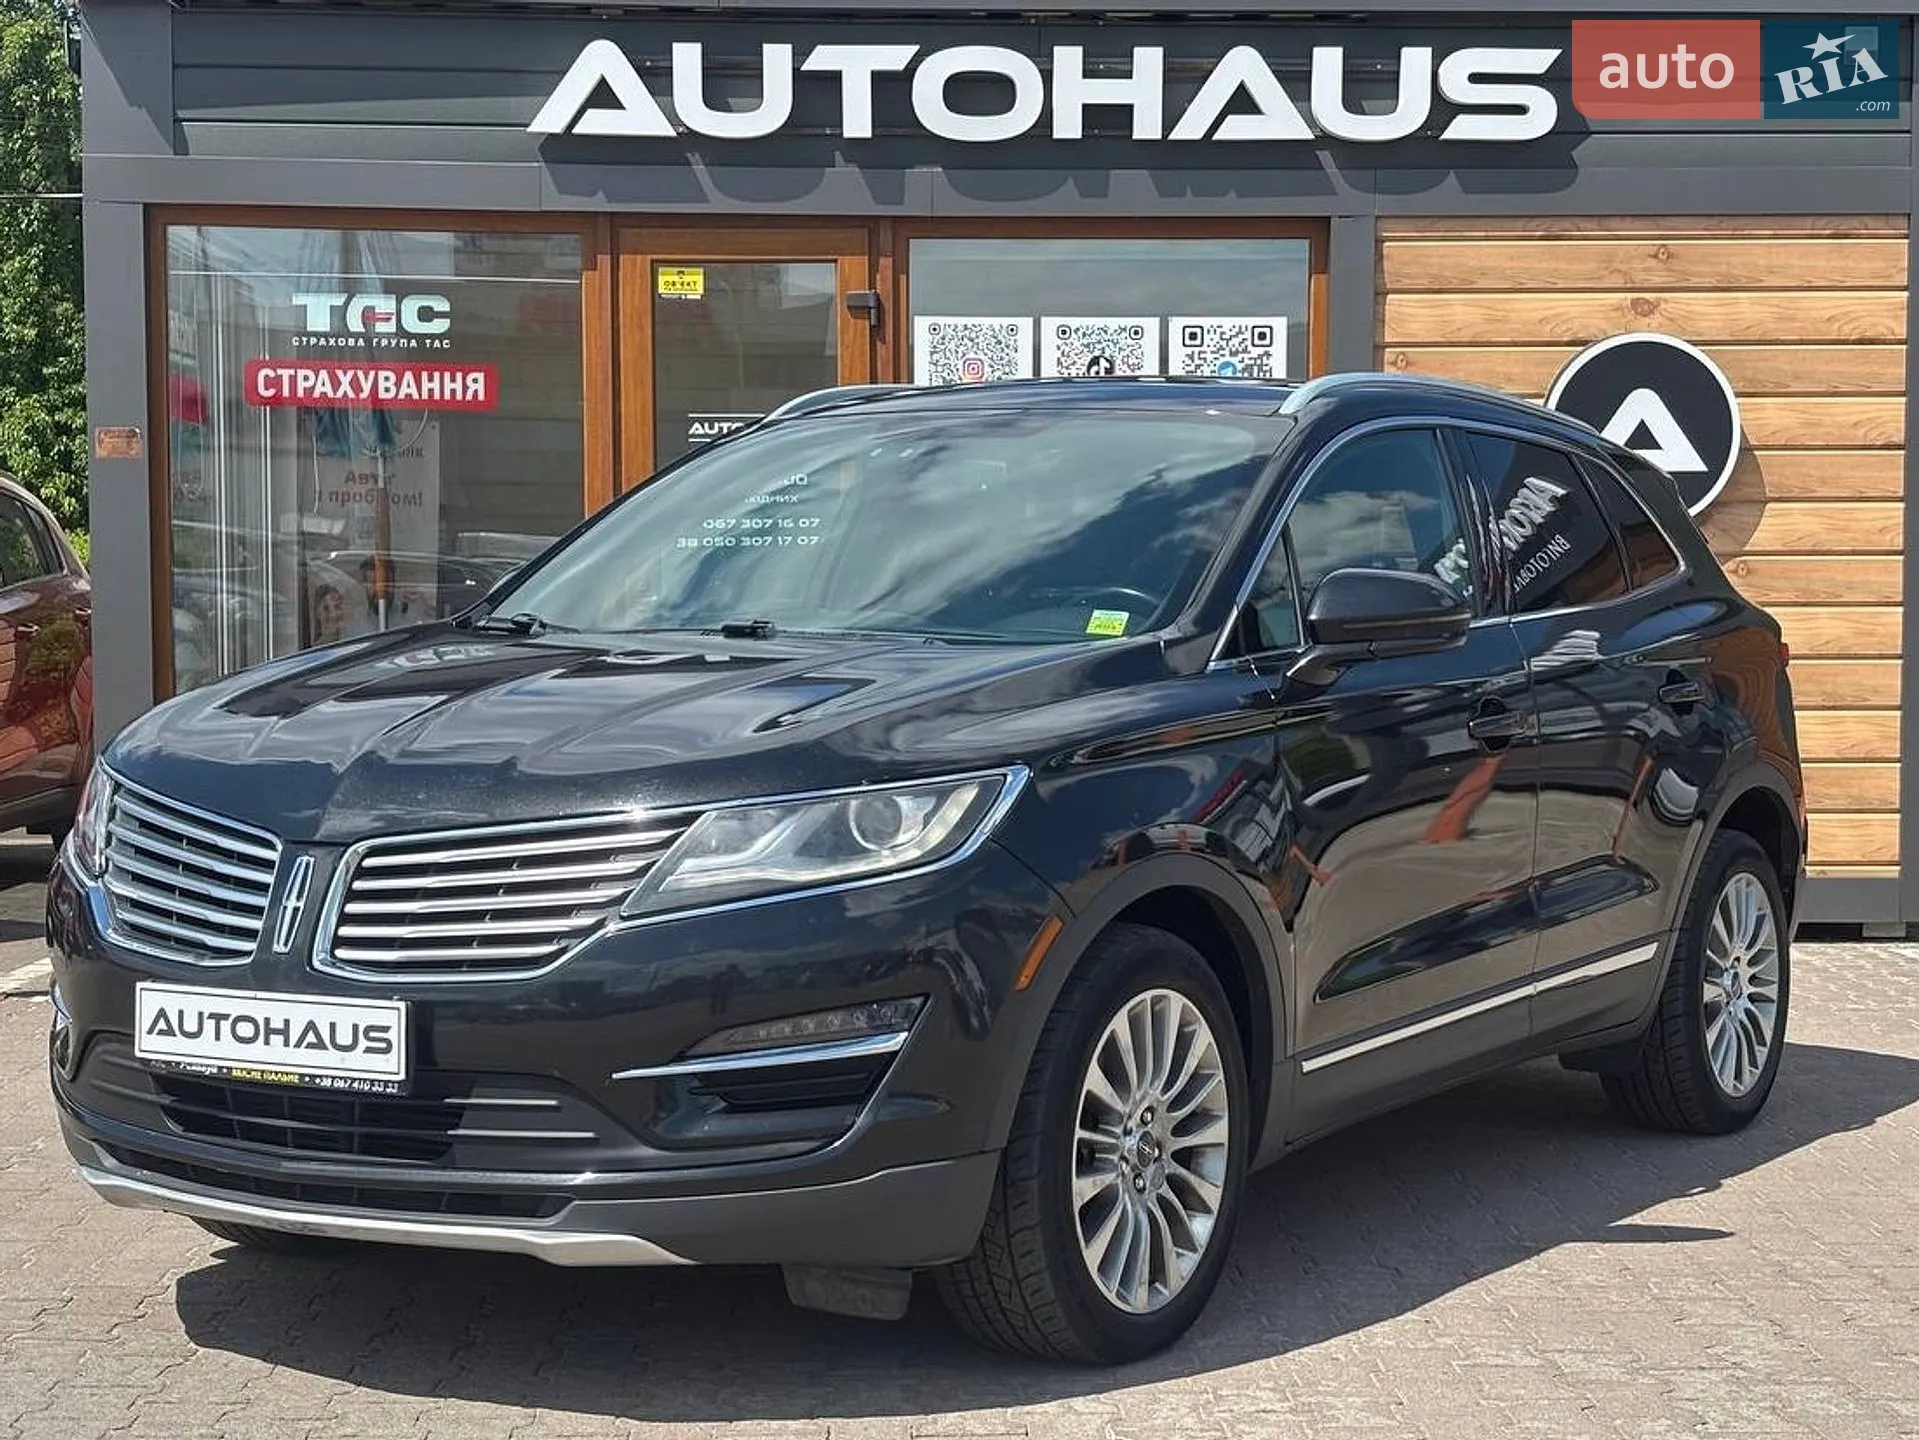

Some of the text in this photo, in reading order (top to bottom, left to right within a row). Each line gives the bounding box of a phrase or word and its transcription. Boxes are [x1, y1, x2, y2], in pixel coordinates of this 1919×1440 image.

[527, 38, 1562, 142] AUTOHAUS
[291, 292, 451, 334] ТАС
[291, 336, 451, 348] СТРАХОВА ГРУПА ТАС
[257, 367, 487, 401] СТРАХУВАННЯ
[1598, 387, 1709, 473] A
[797, 535, 820, 545] 07
[798, 517, 821, 528] 07
[146, 1006, 393, 1055] AUTOHAUS
